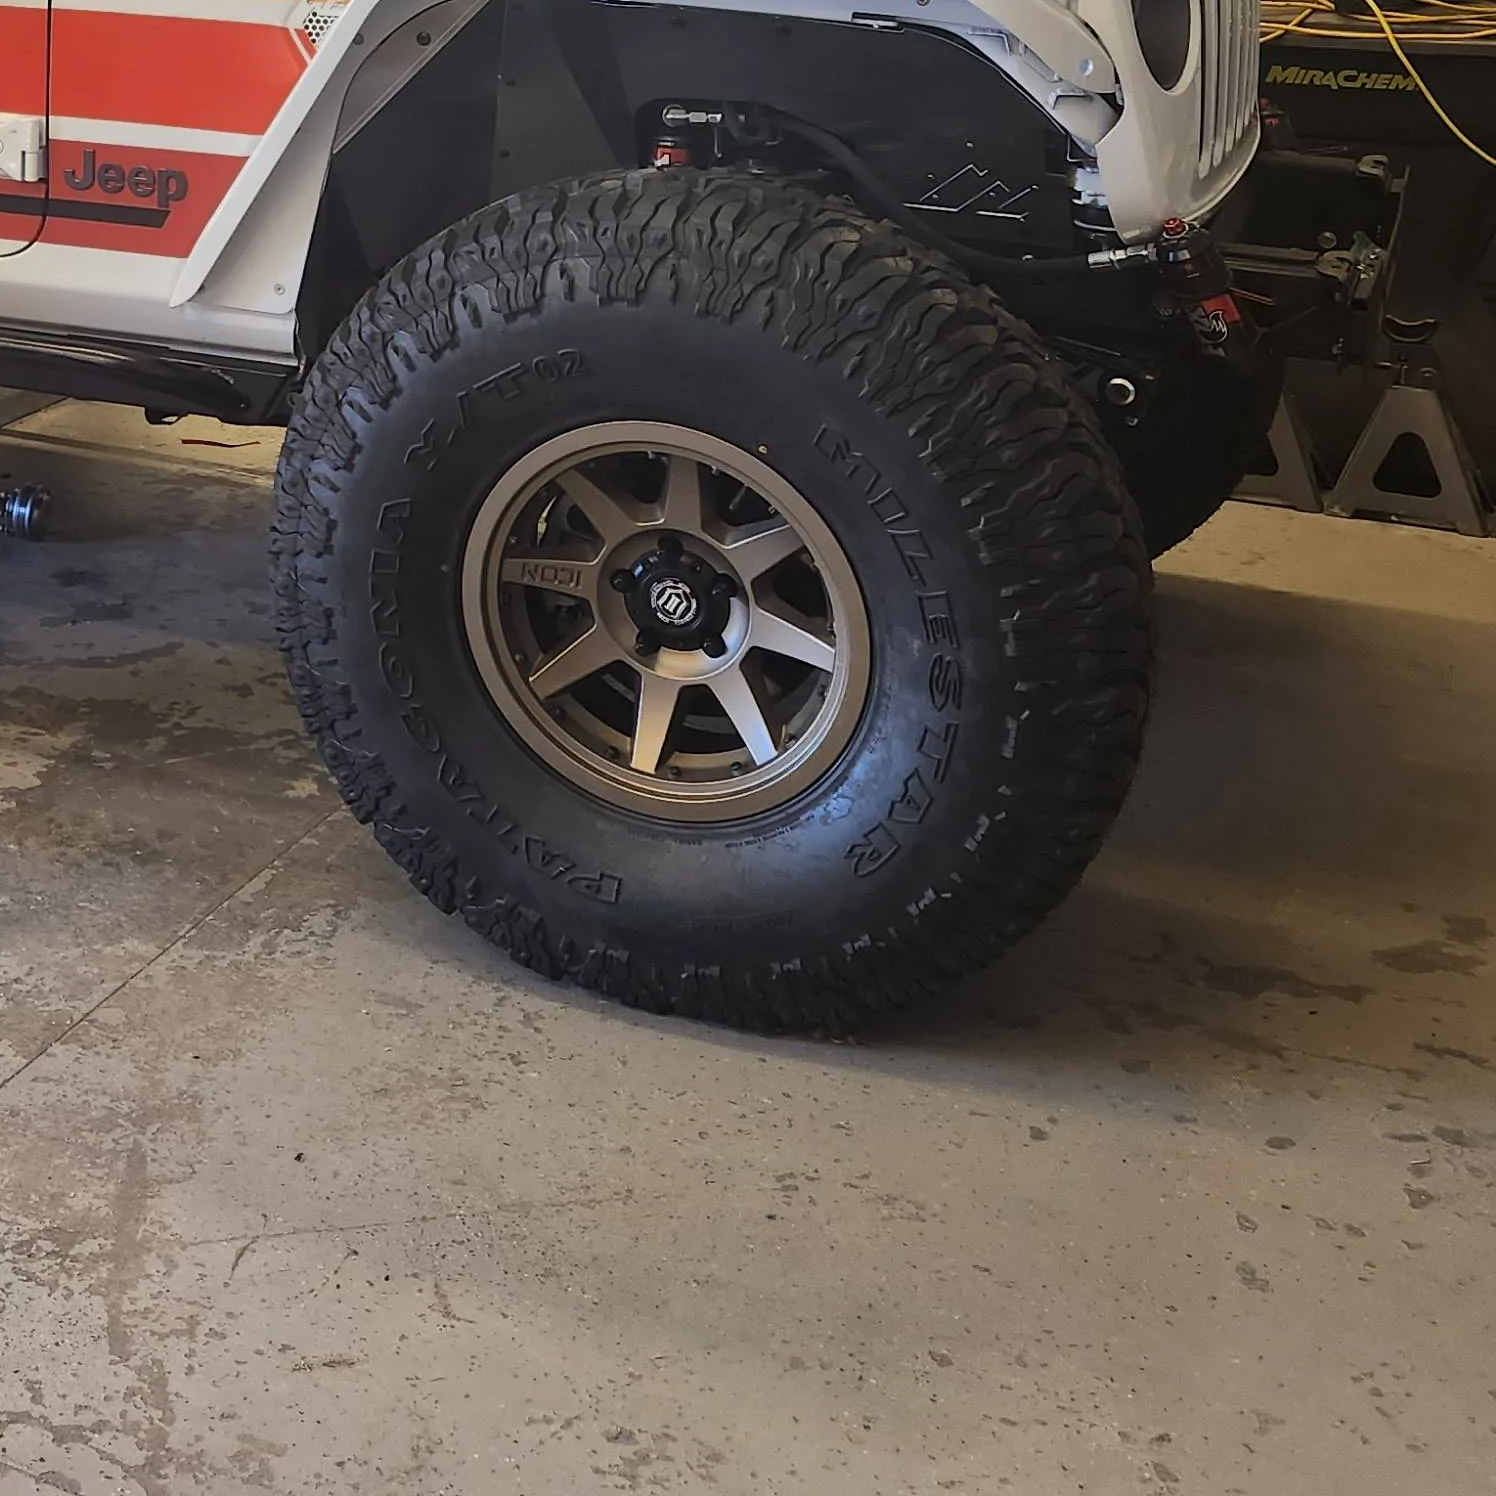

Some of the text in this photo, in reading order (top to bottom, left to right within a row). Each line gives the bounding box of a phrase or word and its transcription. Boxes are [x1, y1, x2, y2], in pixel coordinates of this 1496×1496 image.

[64, 148, 188, 209] Jeep
[521, 562, 583, 590] ICON
[812, 422, 964, 879] MILESTAR
